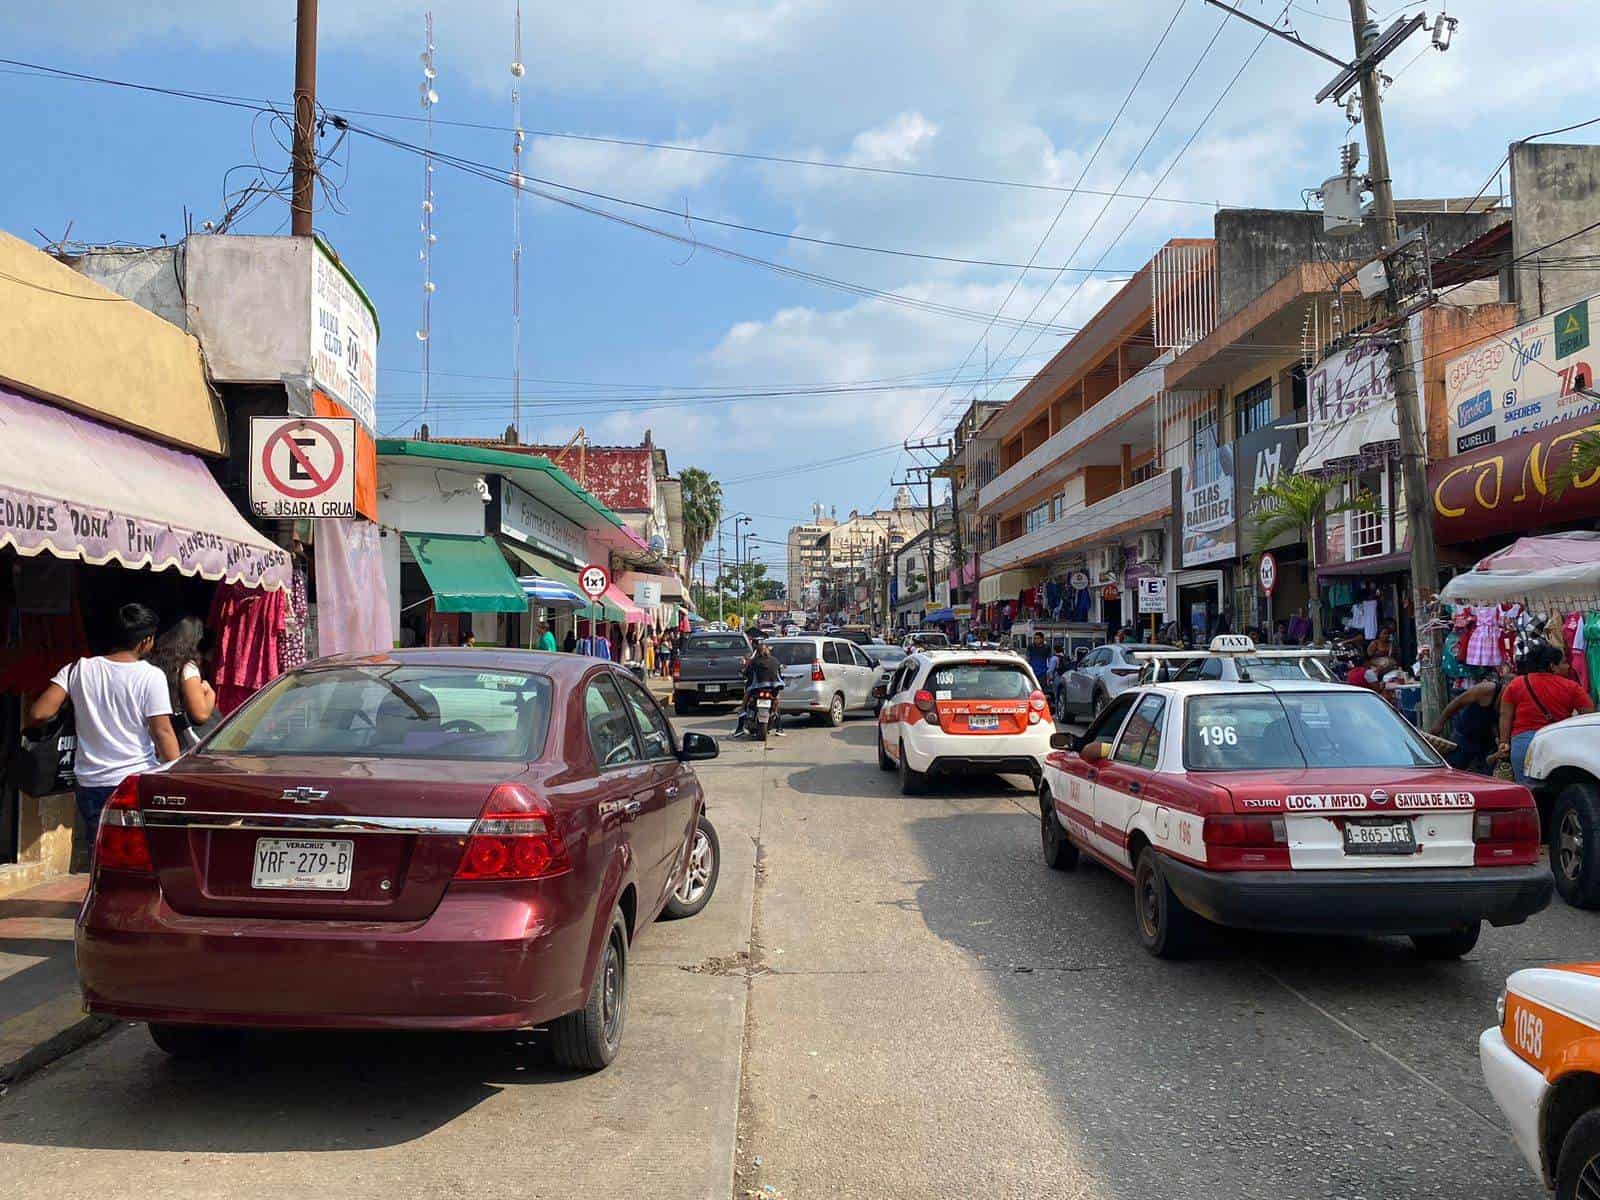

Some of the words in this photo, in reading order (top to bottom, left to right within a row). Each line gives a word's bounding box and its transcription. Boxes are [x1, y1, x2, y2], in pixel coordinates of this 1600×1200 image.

[1504, 401, 1541, 423] SKECHERS
[1551, 398, 1600, 425] CALIDA
[290, 438, 315, 480] E
[1193, 484, 1220, 508] TELAS
[254, 501, 268, 515] SE
[275, 501, 315, 515] USARA
[321, 501, 353, 515] GRUA
[1186, 500, 1230, 527] RAMIREZ
[584, 576, 604, 587] 1x1
[1148, 581, 1158, 593] E
[1221, 637, 1248, 647] TAXI
[1200, 726, 1237, 745] 196
[1242, 799, 1280, 807] TSURU
[1289, 796, 1315, 808] LOC.
[1321, 796, 1328, 807] Y
[1331, 795, 1365, 808] MPIO.
[1397, 794, 1430, 806] SAYULA
[1431, 794, 1443, 806] DE
[1455, 794, 1473, 806] VER.
[260, 851, 347, 874] YRF-279-B
[1514, 1005, 1542, 1059] 1058
